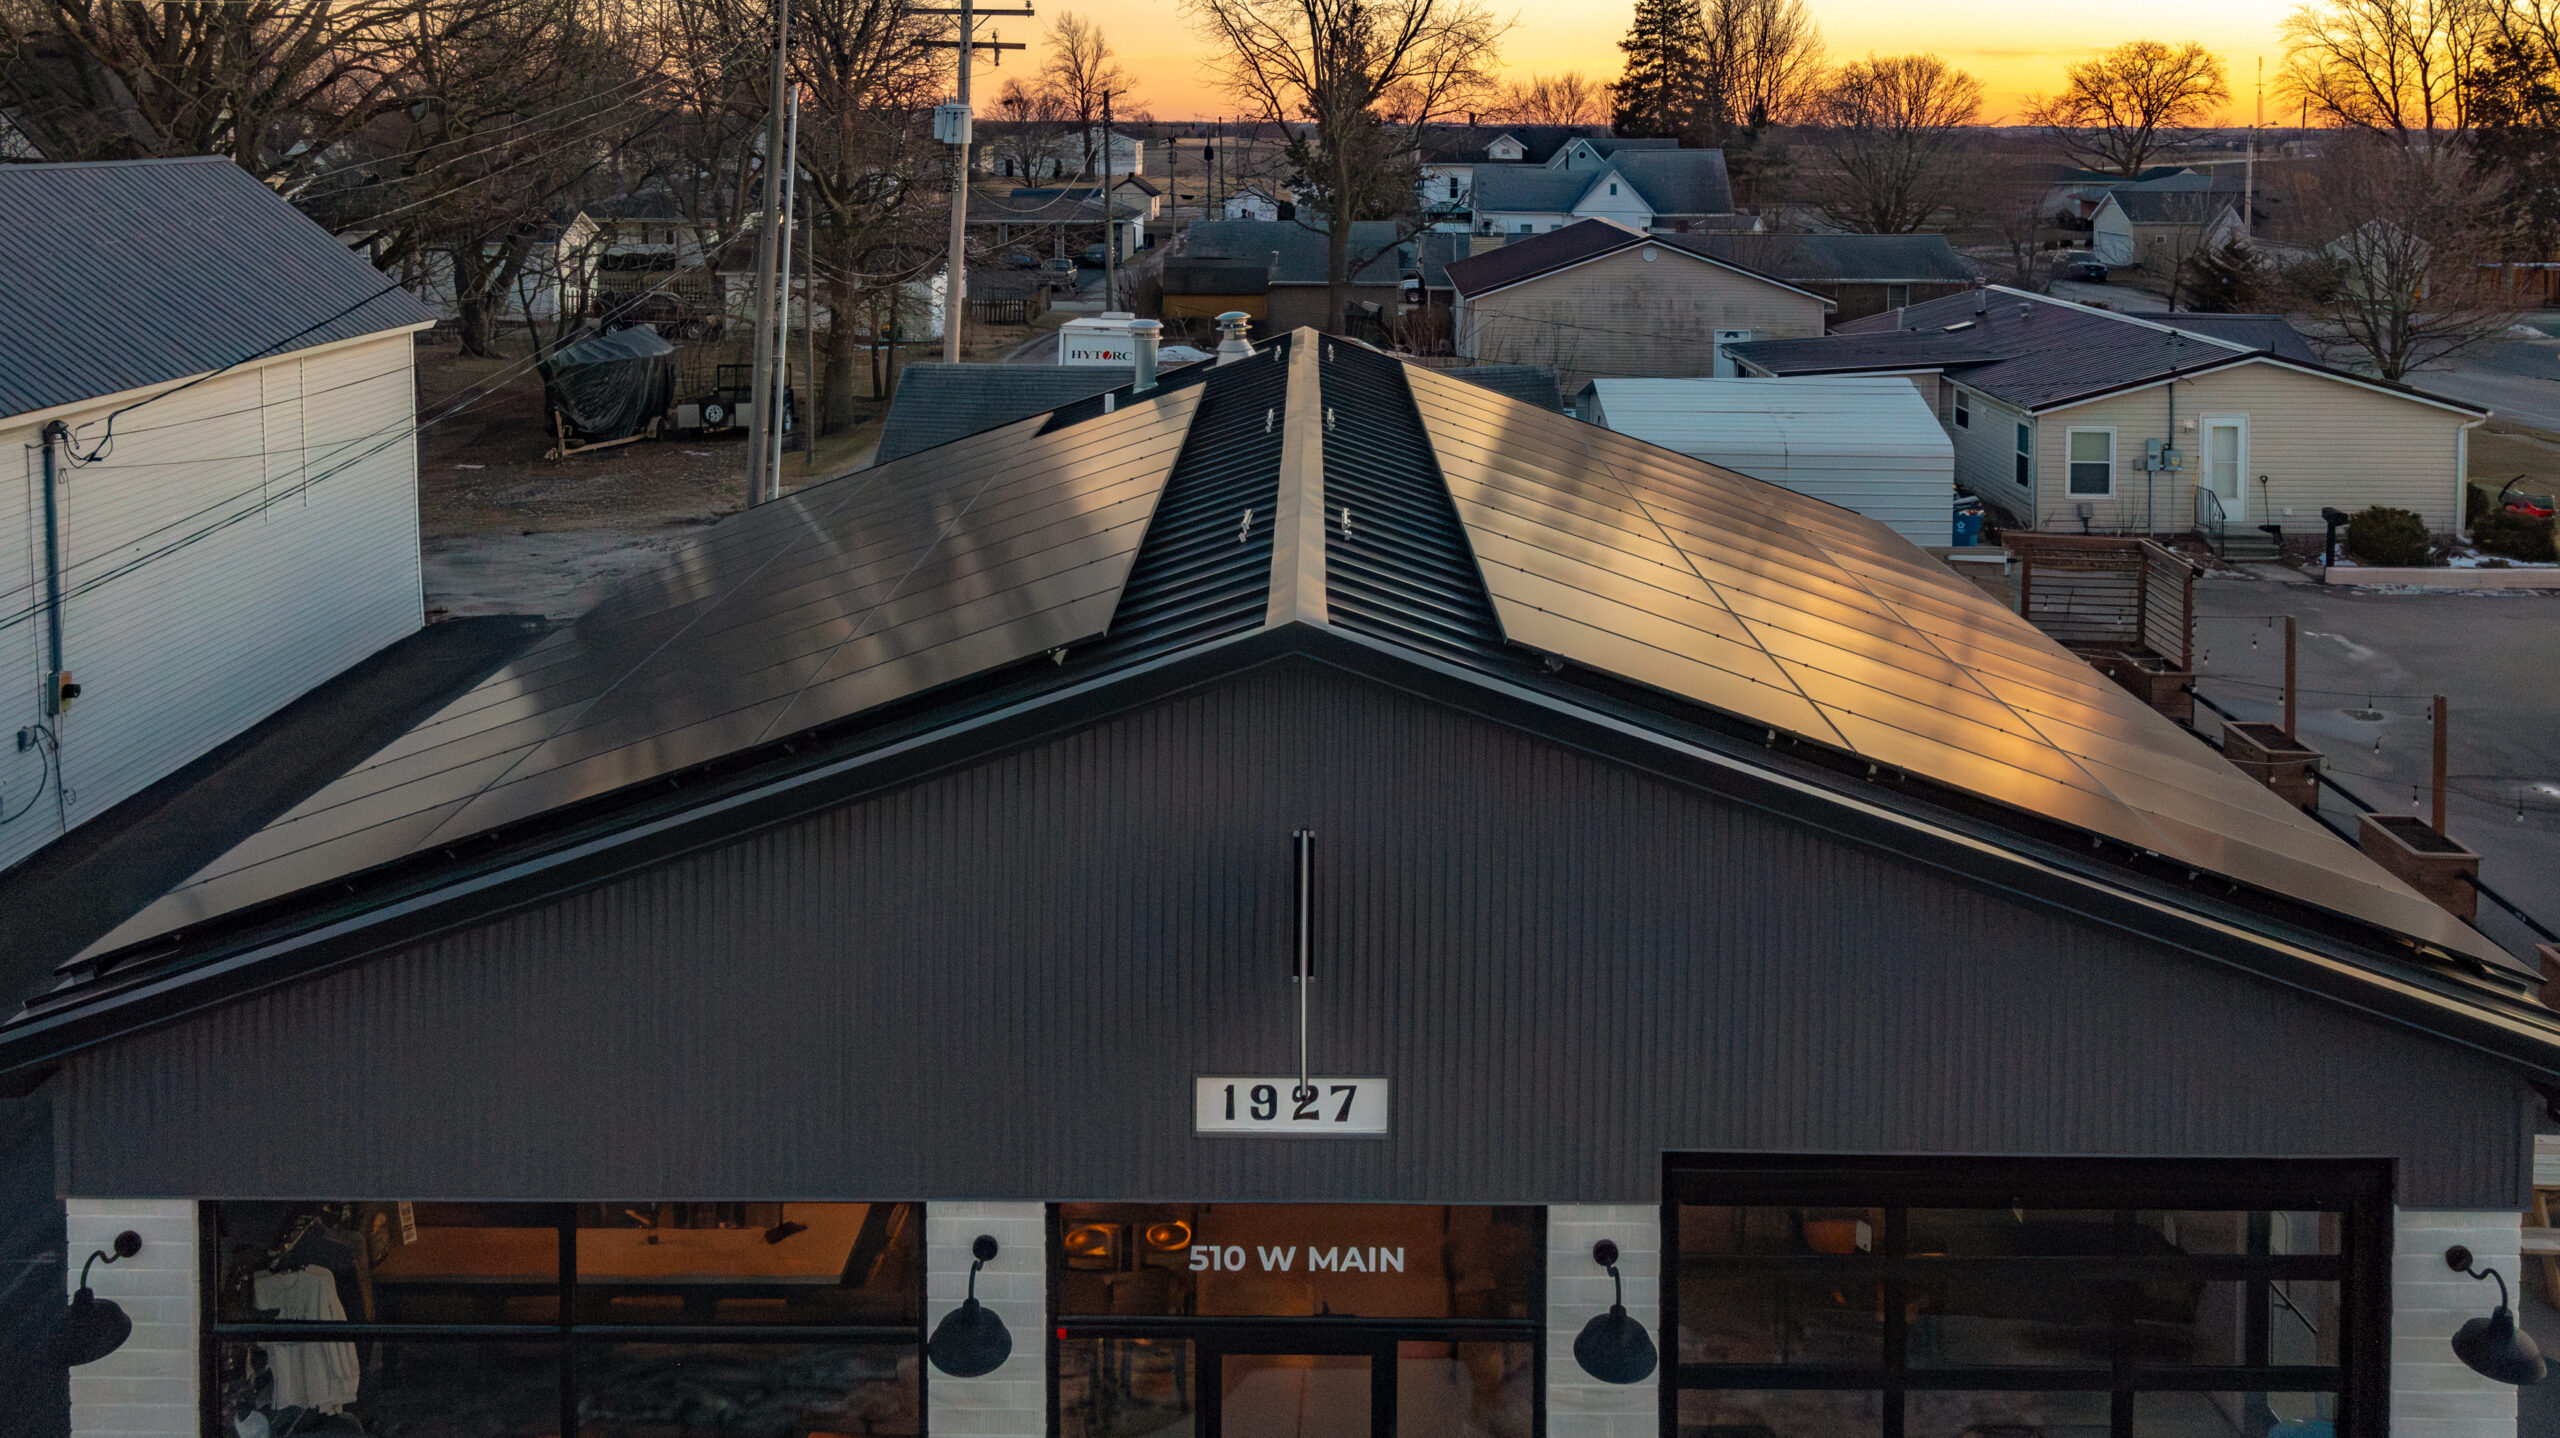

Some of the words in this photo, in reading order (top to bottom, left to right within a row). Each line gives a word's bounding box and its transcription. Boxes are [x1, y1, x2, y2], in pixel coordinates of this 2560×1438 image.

[1071, 349, 1133, 361] HYTORC
[1223, 1084, 1358, 1122] 1927
[1188, 1245, 1246, 1272] 510
[1257, 1246, 1297, 1272] W
[1308, 1246, 1405, 1273] MAIN
